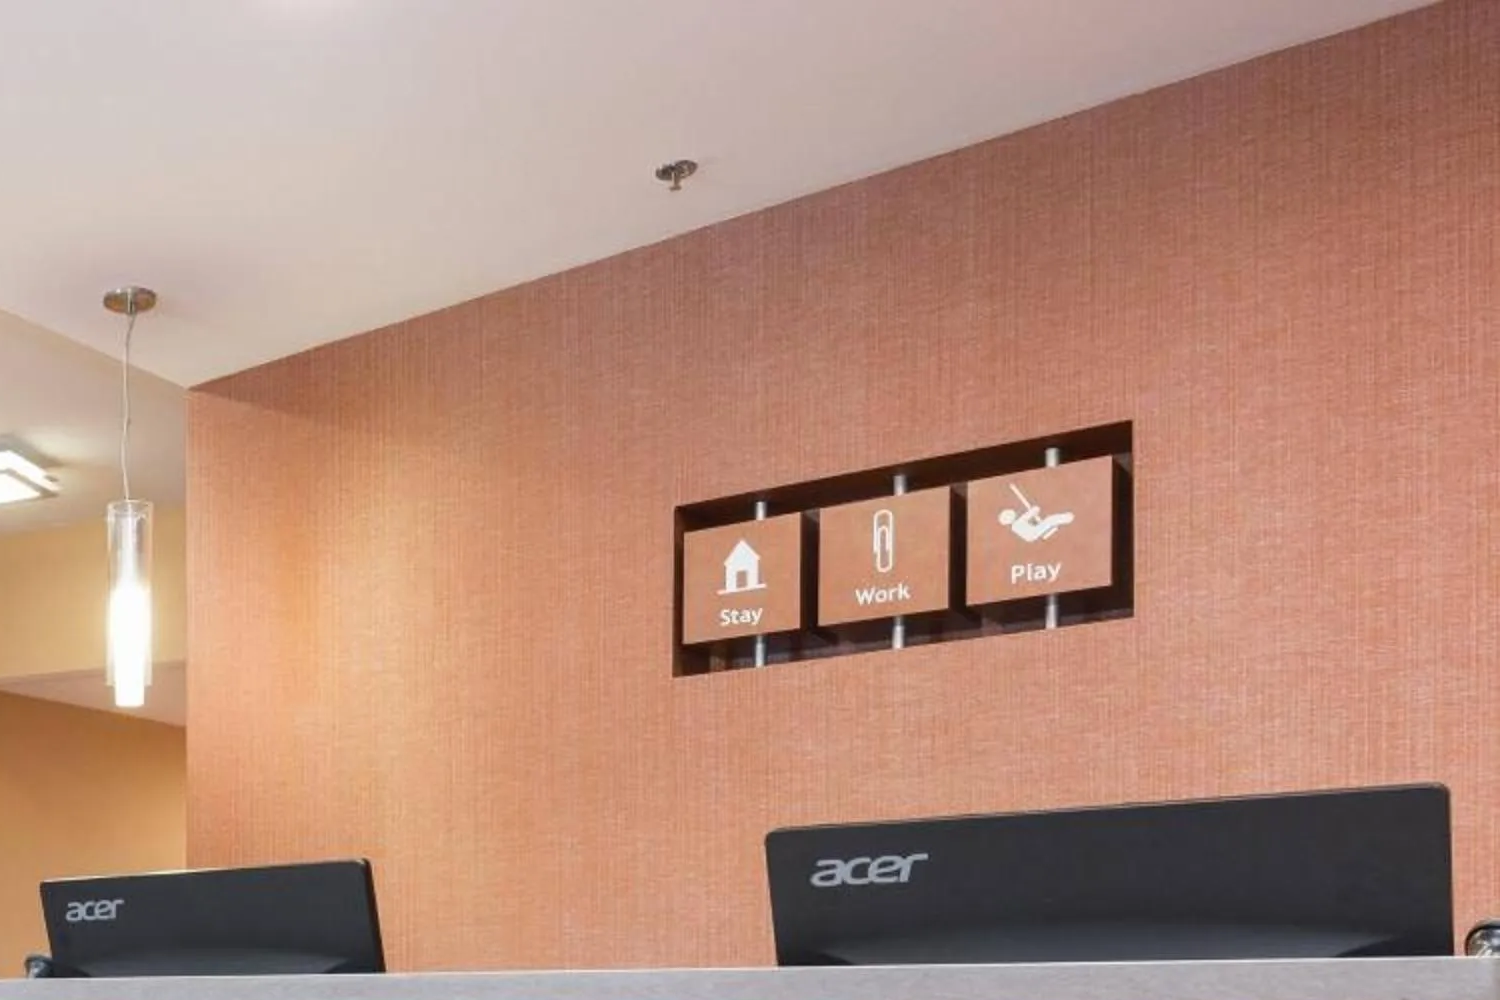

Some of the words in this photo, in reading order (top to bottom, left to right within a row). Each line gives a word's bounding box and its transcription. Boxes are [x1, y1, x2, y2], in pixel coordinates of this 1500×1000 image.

[1011, 562, 1061, 584] Play
[855, 582, 911, 606] Work
[719, 607, 763, 626] Stay
[810, 853, 928, 887] acer
[65, 899, 124, 922] acer
